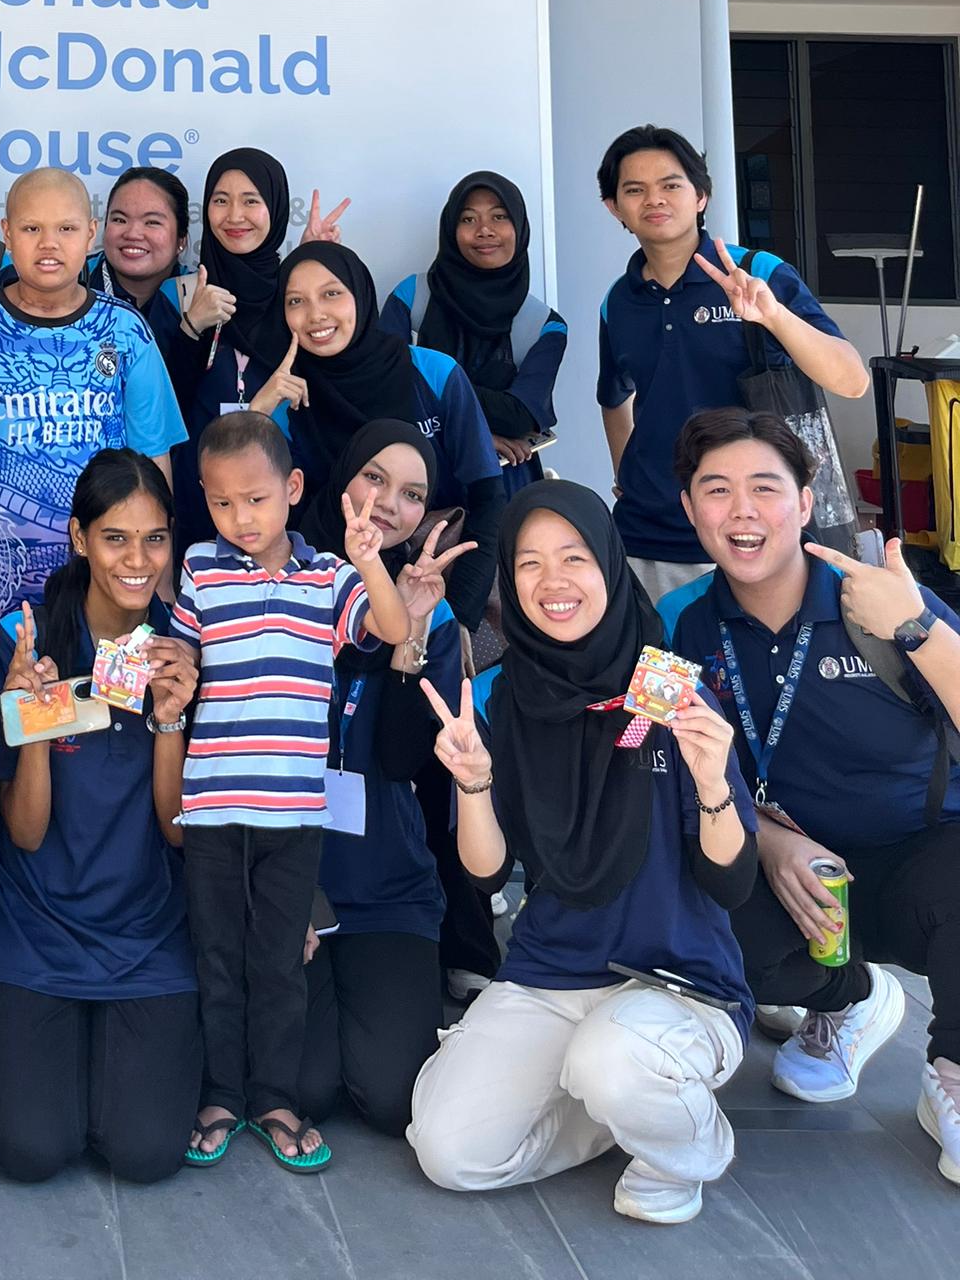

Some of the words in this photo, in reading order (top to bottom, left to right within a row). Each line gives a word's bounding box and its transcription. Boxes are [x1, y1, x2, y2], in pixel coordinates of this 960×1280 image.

[711, 305, 742, 320] UM
[7, 422, 35, 446] FLY
[43, 420, 103, 445] BETTER
[840, 656, 873, 674] UM
